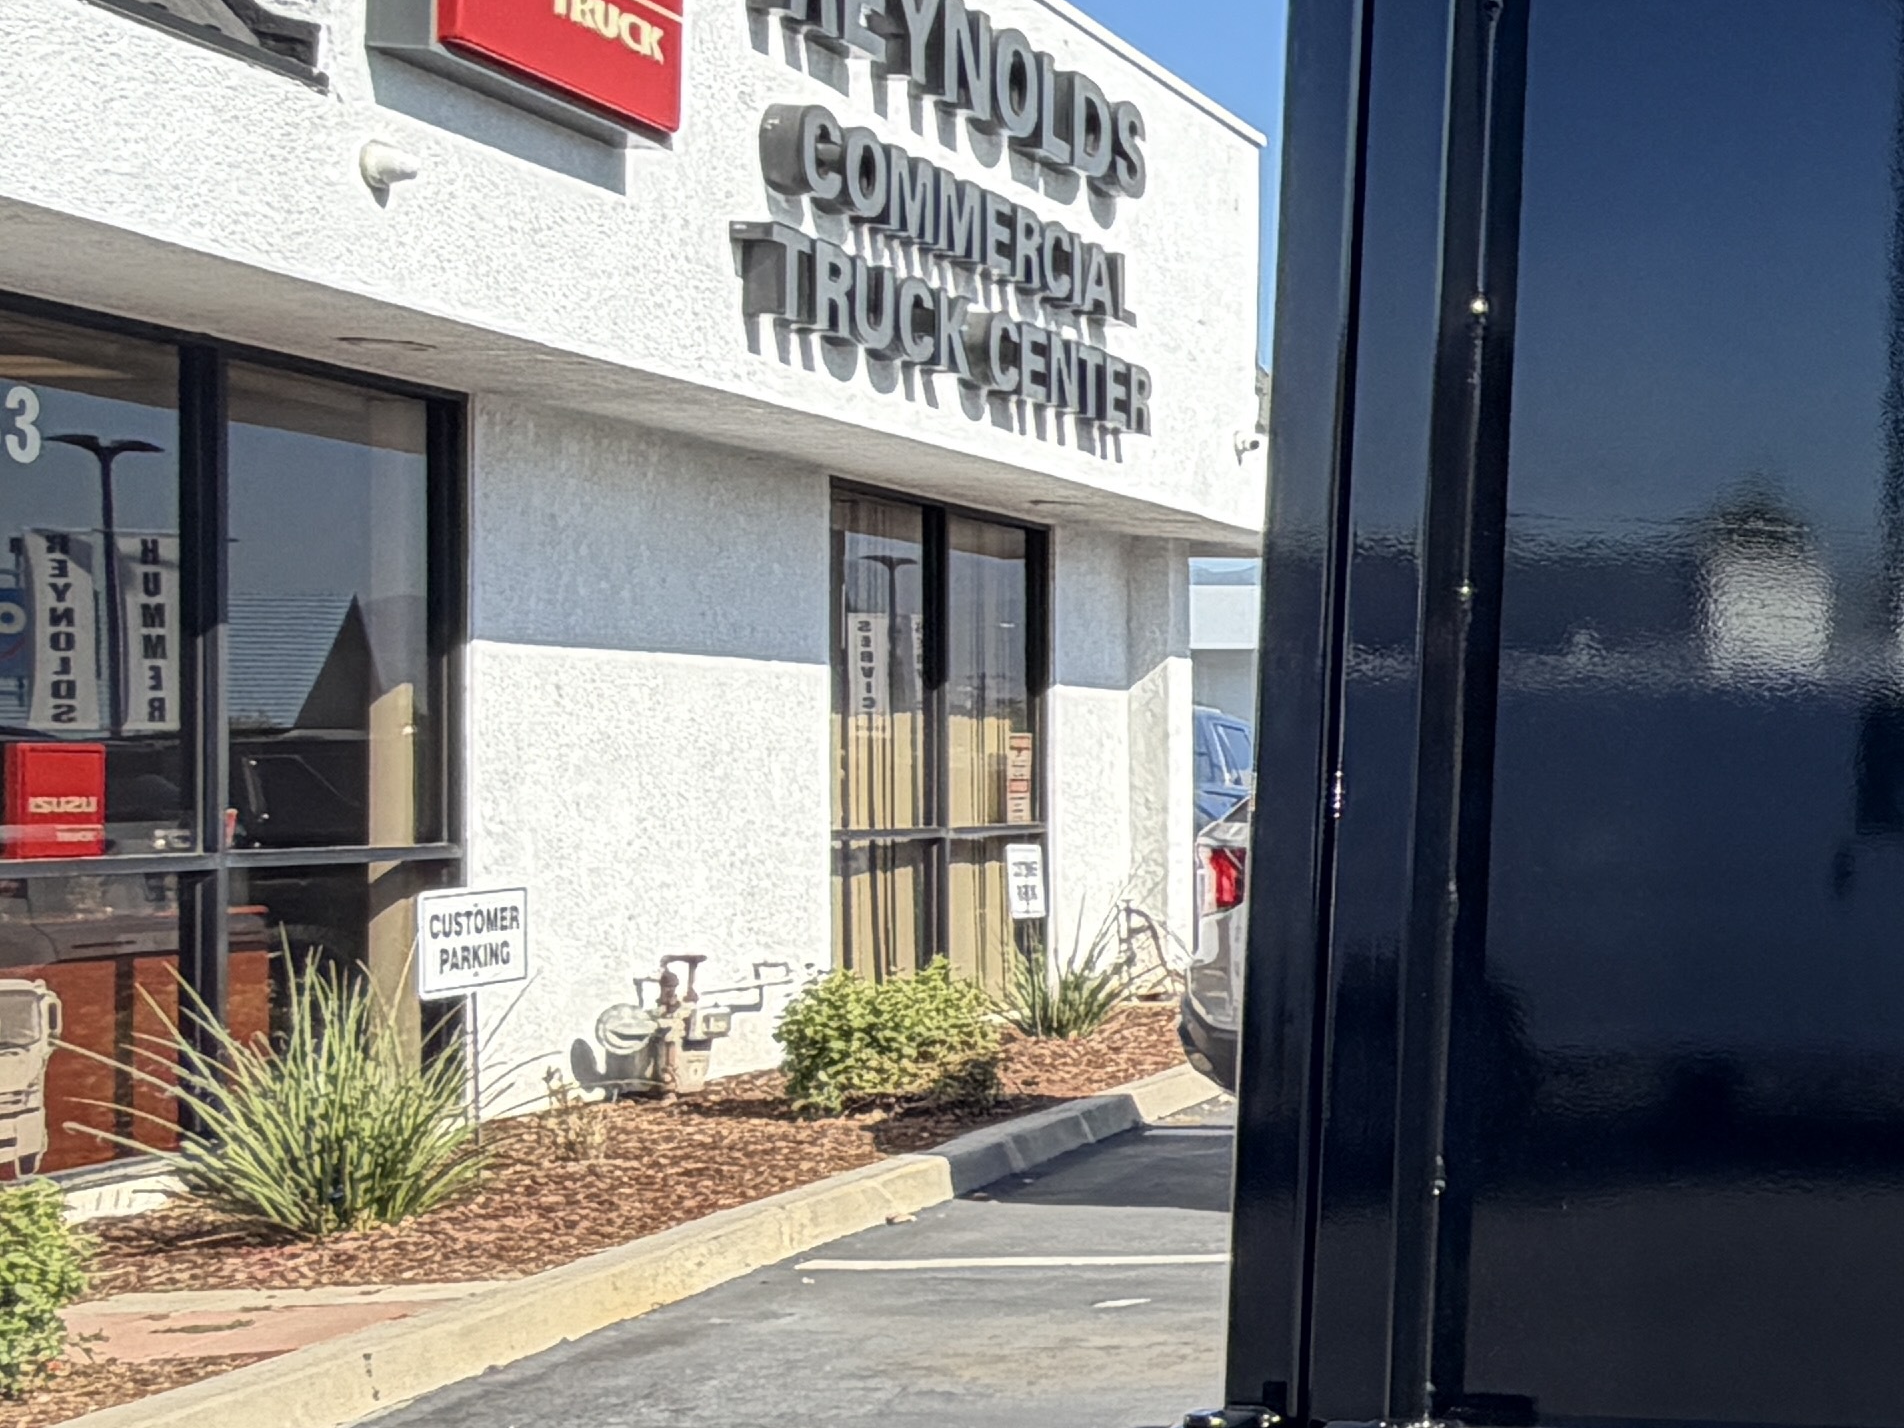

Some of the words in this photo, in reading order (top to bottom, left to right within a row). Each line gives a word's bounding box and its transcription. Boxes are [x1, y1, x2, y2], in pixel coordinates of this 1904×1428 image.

[764, 104, 1137, 329] COMMERCIAL
[735, 221, 968, 373] TRUCK
[984, 311, 1152, 436] CENTER
[3, 385, 42, 465] 3
[28, 796, 98, 813] ISUZU
[429, 905, 520, 940] CUSTOMER
[439, 940, 510, 975] PARKING
